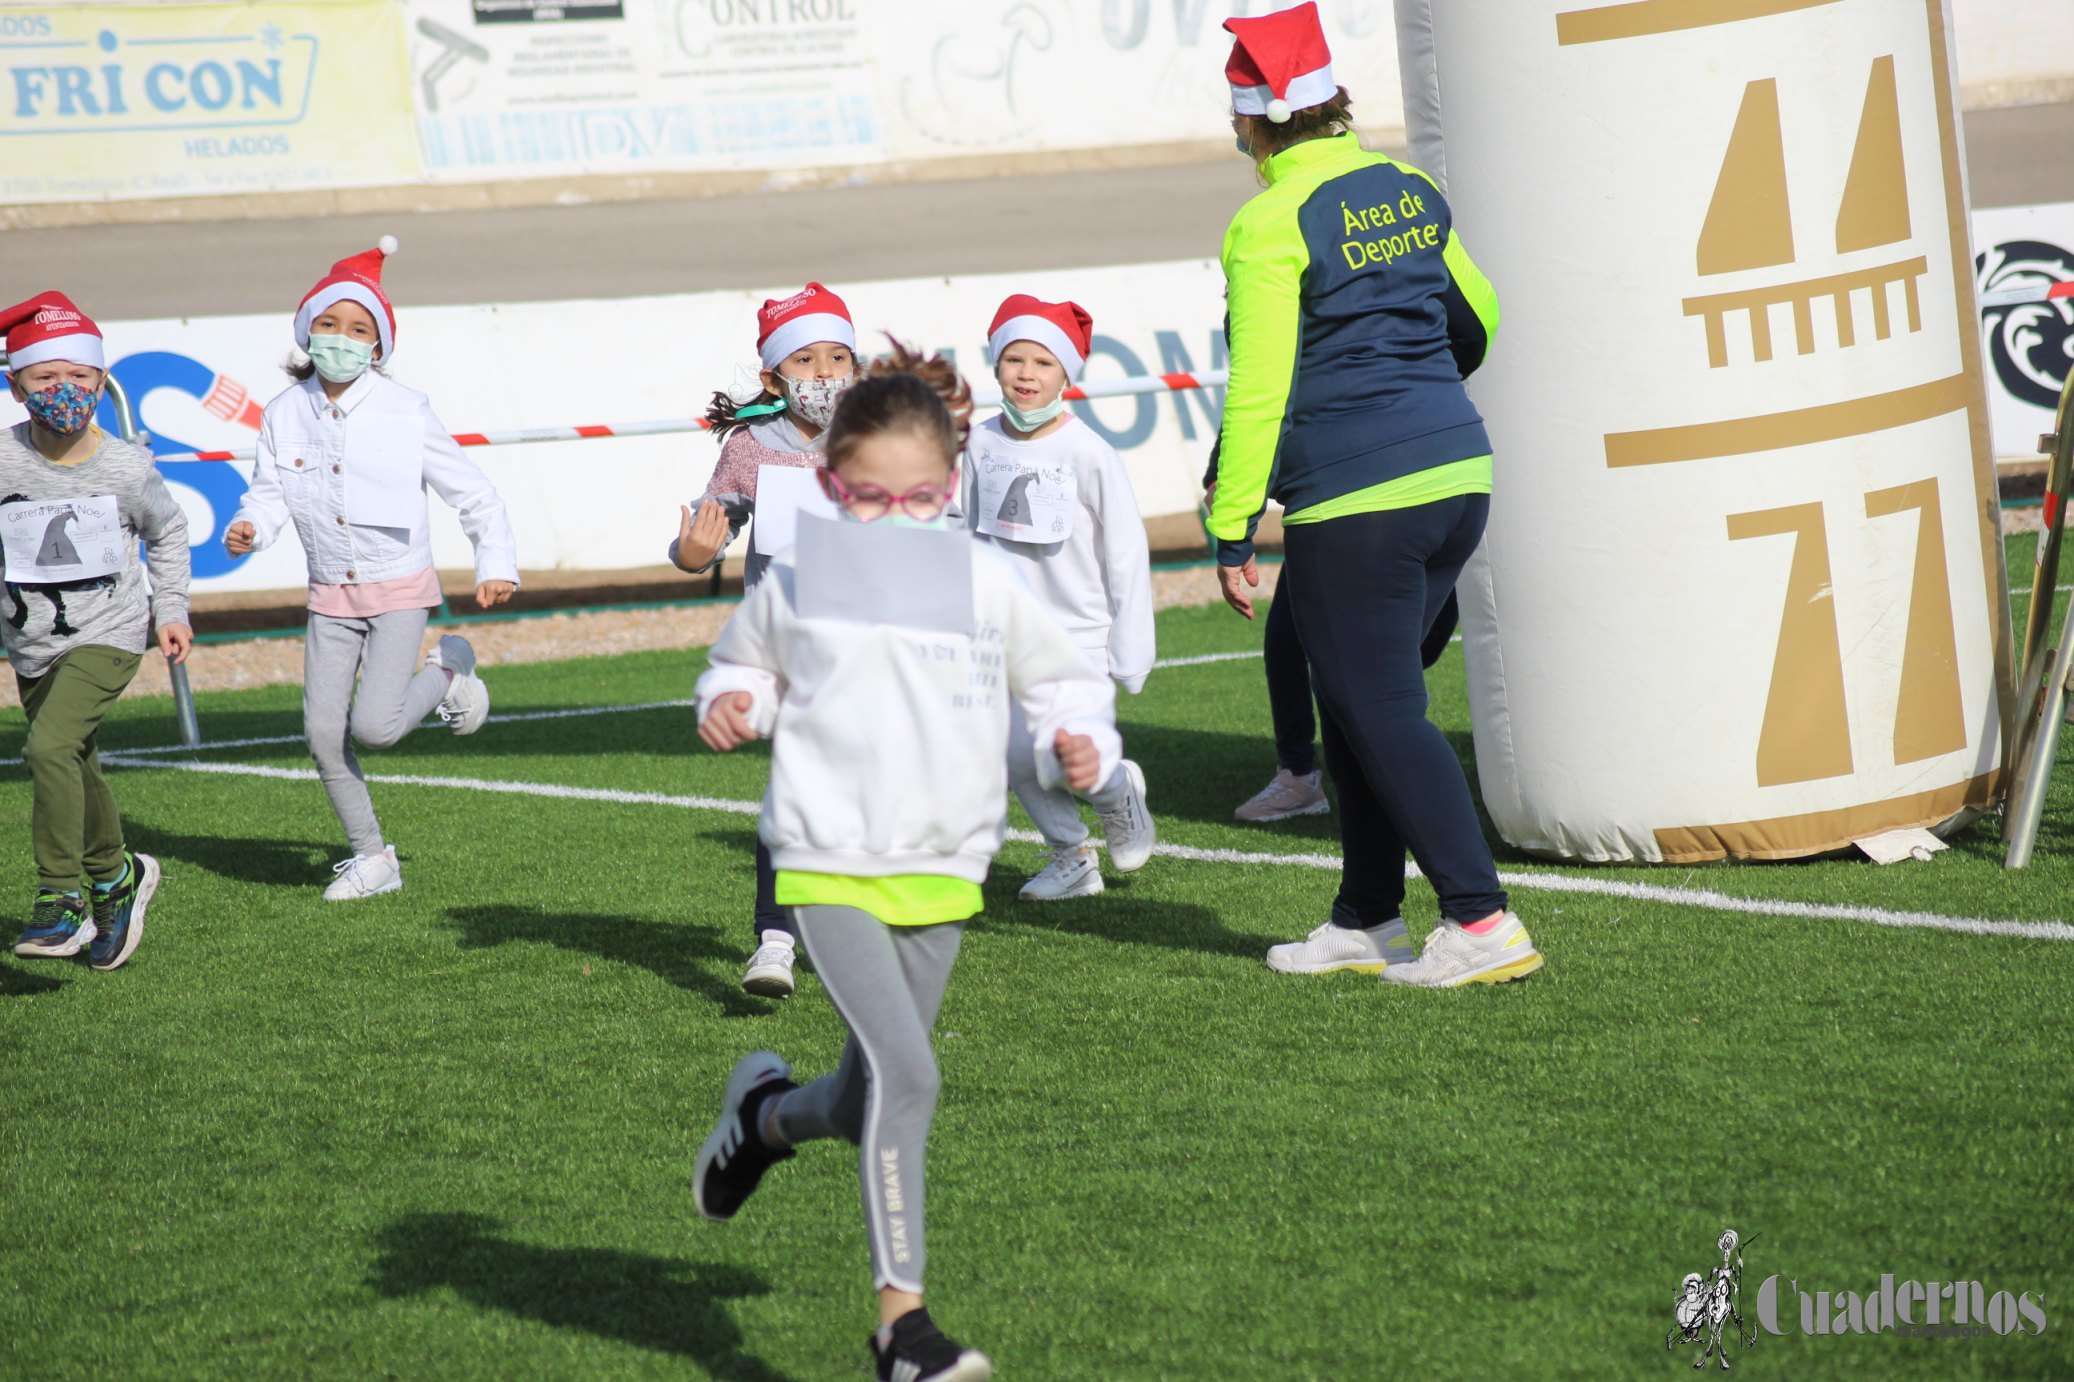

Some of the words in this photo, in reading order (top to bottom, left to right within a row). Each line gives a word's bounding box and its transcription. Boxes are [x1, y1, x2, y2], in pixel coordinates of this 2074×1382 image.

[0, 14, 53, 37] DOS
[144, 58, 284, 112] CON
[184, 134, 290, 158] HELADOS
[1341, 200, 1397, 236] Área
[1400, 190, 1426, 219] de
[35, 310, 82, 325] TOMELLOSO
[985, 463, 1013, 474] Carrera
[8, 507, 44, 523] Carrera
[1009, 499, 1018, 516] 3
[51, 541, 63, 559] 1
[881, 1146, 904, 1212] BRAVE
[889, 1216, 911, 1263] STAY
